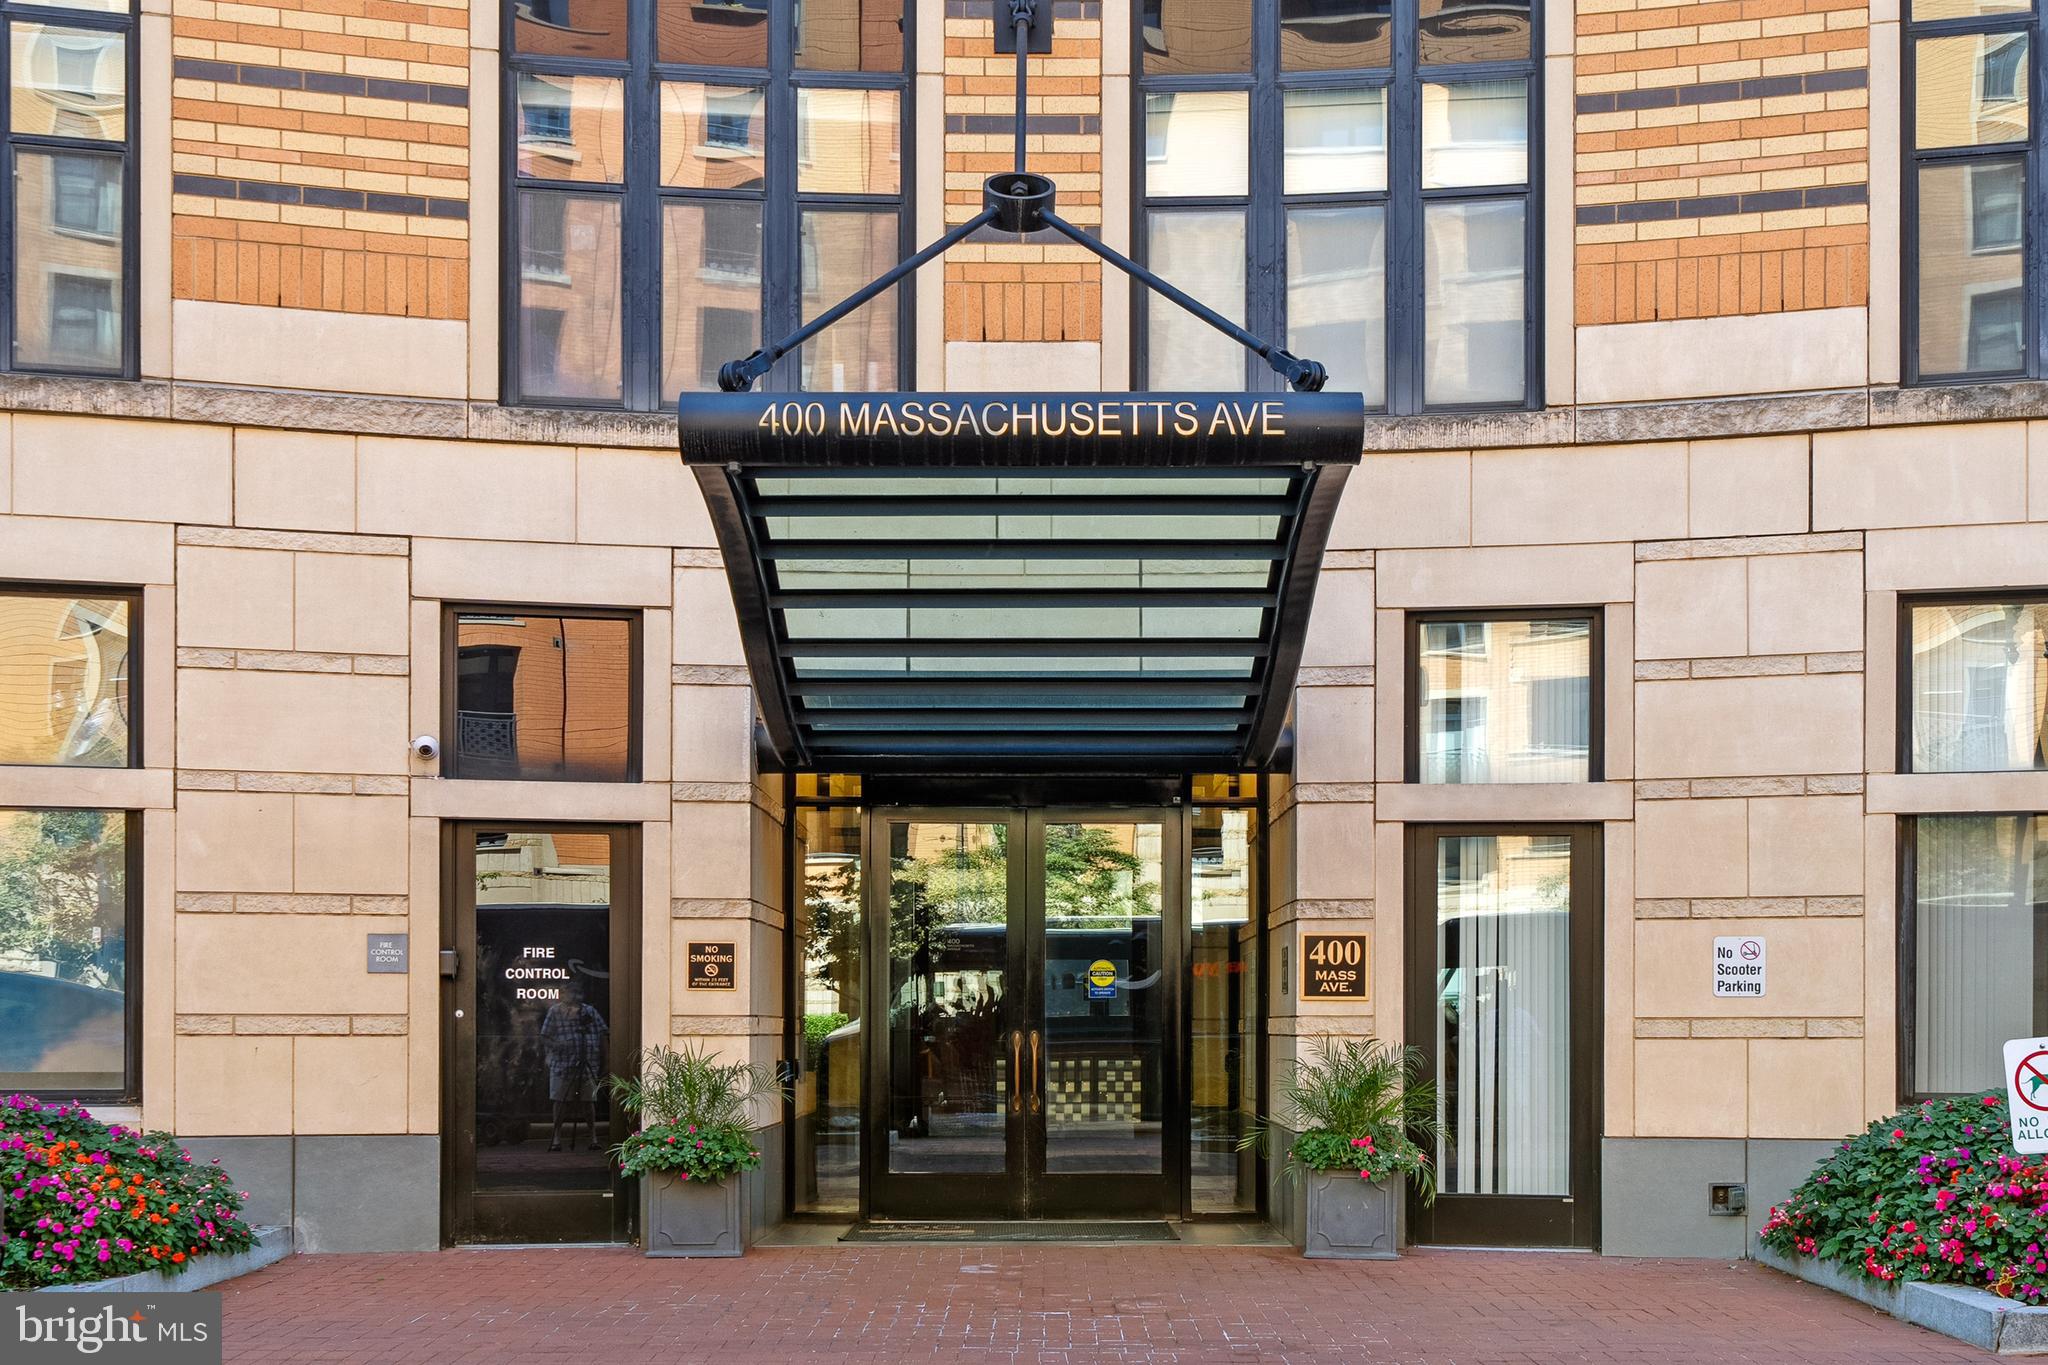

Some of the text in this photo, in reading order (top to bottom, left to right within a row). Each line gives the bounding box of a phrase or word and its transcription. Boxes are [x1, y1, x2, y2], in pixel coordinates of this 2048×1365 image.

[758, 402, 1287, 436] 400 MASSACHUSETTS AVE
[523, 947, 556, 958] FIRE
[705, 945, 719, 953] NO
[1309, 940, 1361, 965] 400
[1717, 947, 1733, 958] No
[690, 955, 733, 963] SMOKING
[505, 968, 570, 979] CONTROL
[1717, 963, 1762, 975] Scooter
[1315, 970, 1357, 980] MASS
[1319, 982, 1352, 992] AVE.
[1717, 980, 1761, 994] Parking
[516, 988, 560, 999] ROOM
[2019, 1117, 2039, 1127] NO
